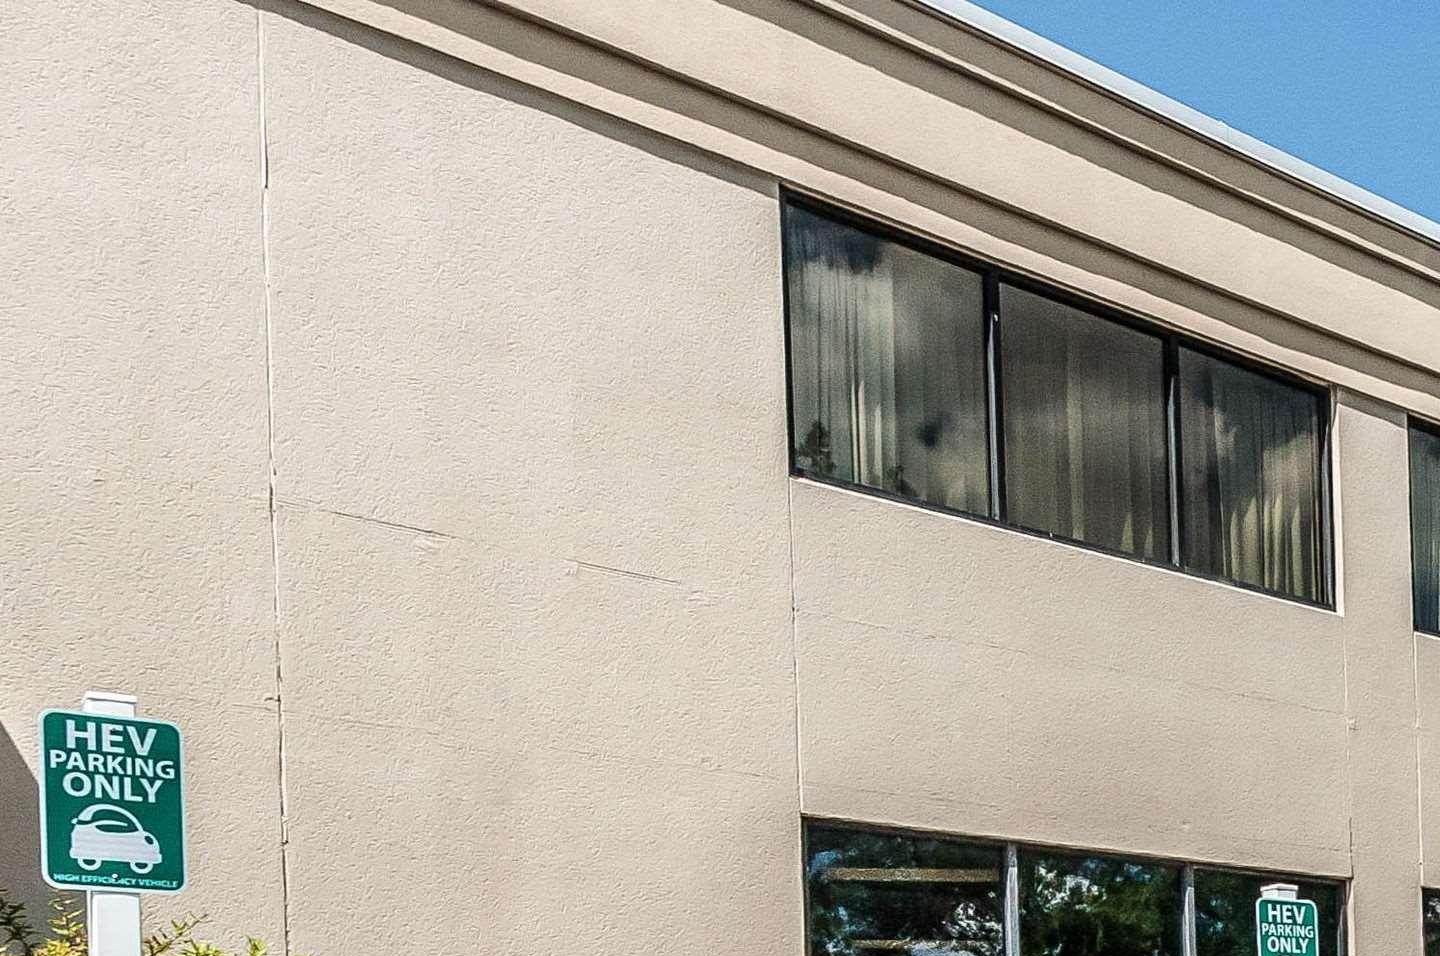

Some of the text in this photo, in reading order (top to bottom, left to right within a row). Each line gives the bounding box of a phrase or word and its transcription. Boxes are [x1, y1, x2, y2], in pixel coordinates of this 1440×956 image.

[65, 719, 157, 756] HEV
[49, 749, 176, 779] PARKING
[62, 772, 164, 803] ONLY
[1267, 903, 1306, 925] HEV
[1261, 922, 1315, 939] PARKING
[1267, 935, 1310, 954] ONLY
